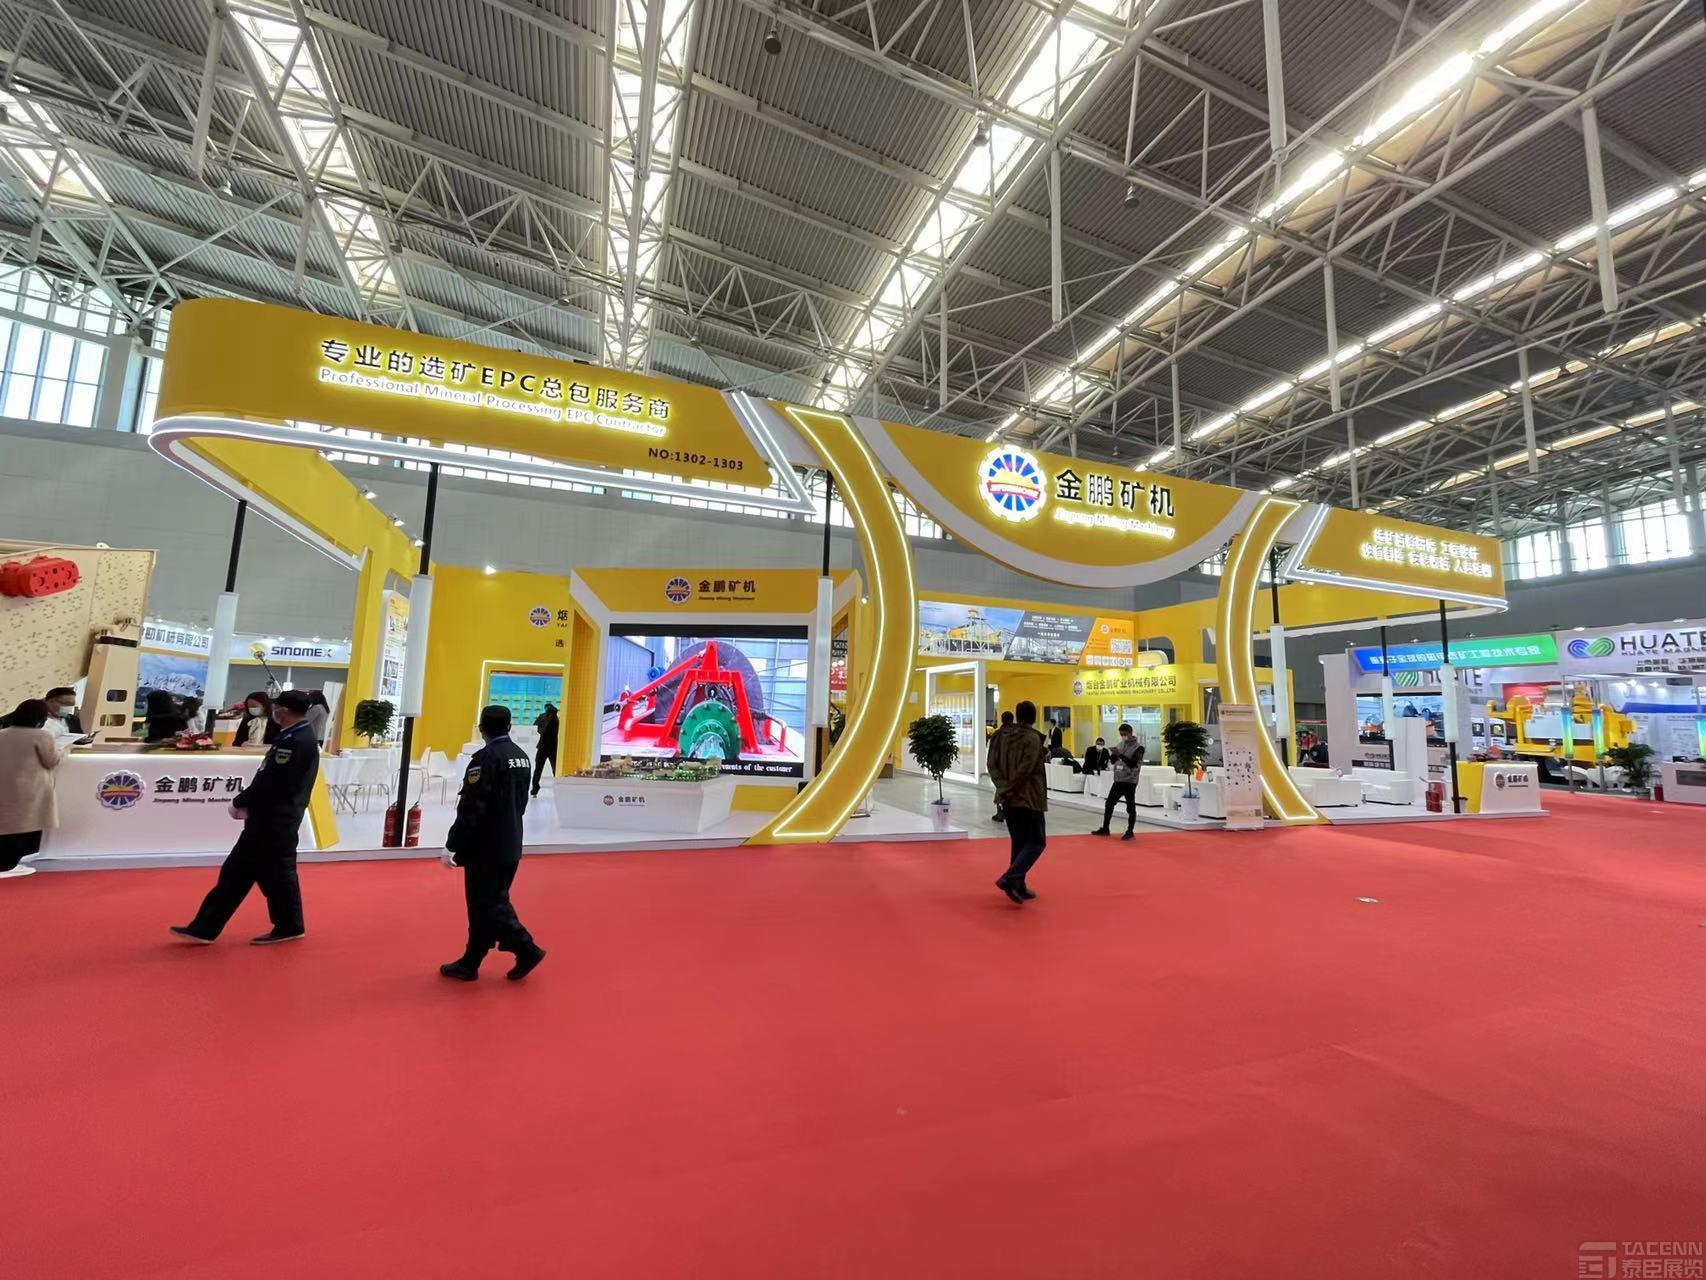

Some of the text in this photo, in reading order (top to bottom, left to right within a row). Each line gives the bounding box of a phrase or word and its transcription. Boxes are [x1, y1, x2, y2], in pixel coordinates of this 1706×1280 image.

[321, 339, 669, 419] 专业的选矿EPC总包服务商
[320, 367, 666, 437] Professional Mineral Processing EPC Contractor
[648, 447, 744, 470] NO:1302-1303
[1056, 469, 1175, 517] 金鹏矿机
[698, 579, 756, 593] 金鹏矿机
[154, 776, 245, 793] 金鹏矿机
